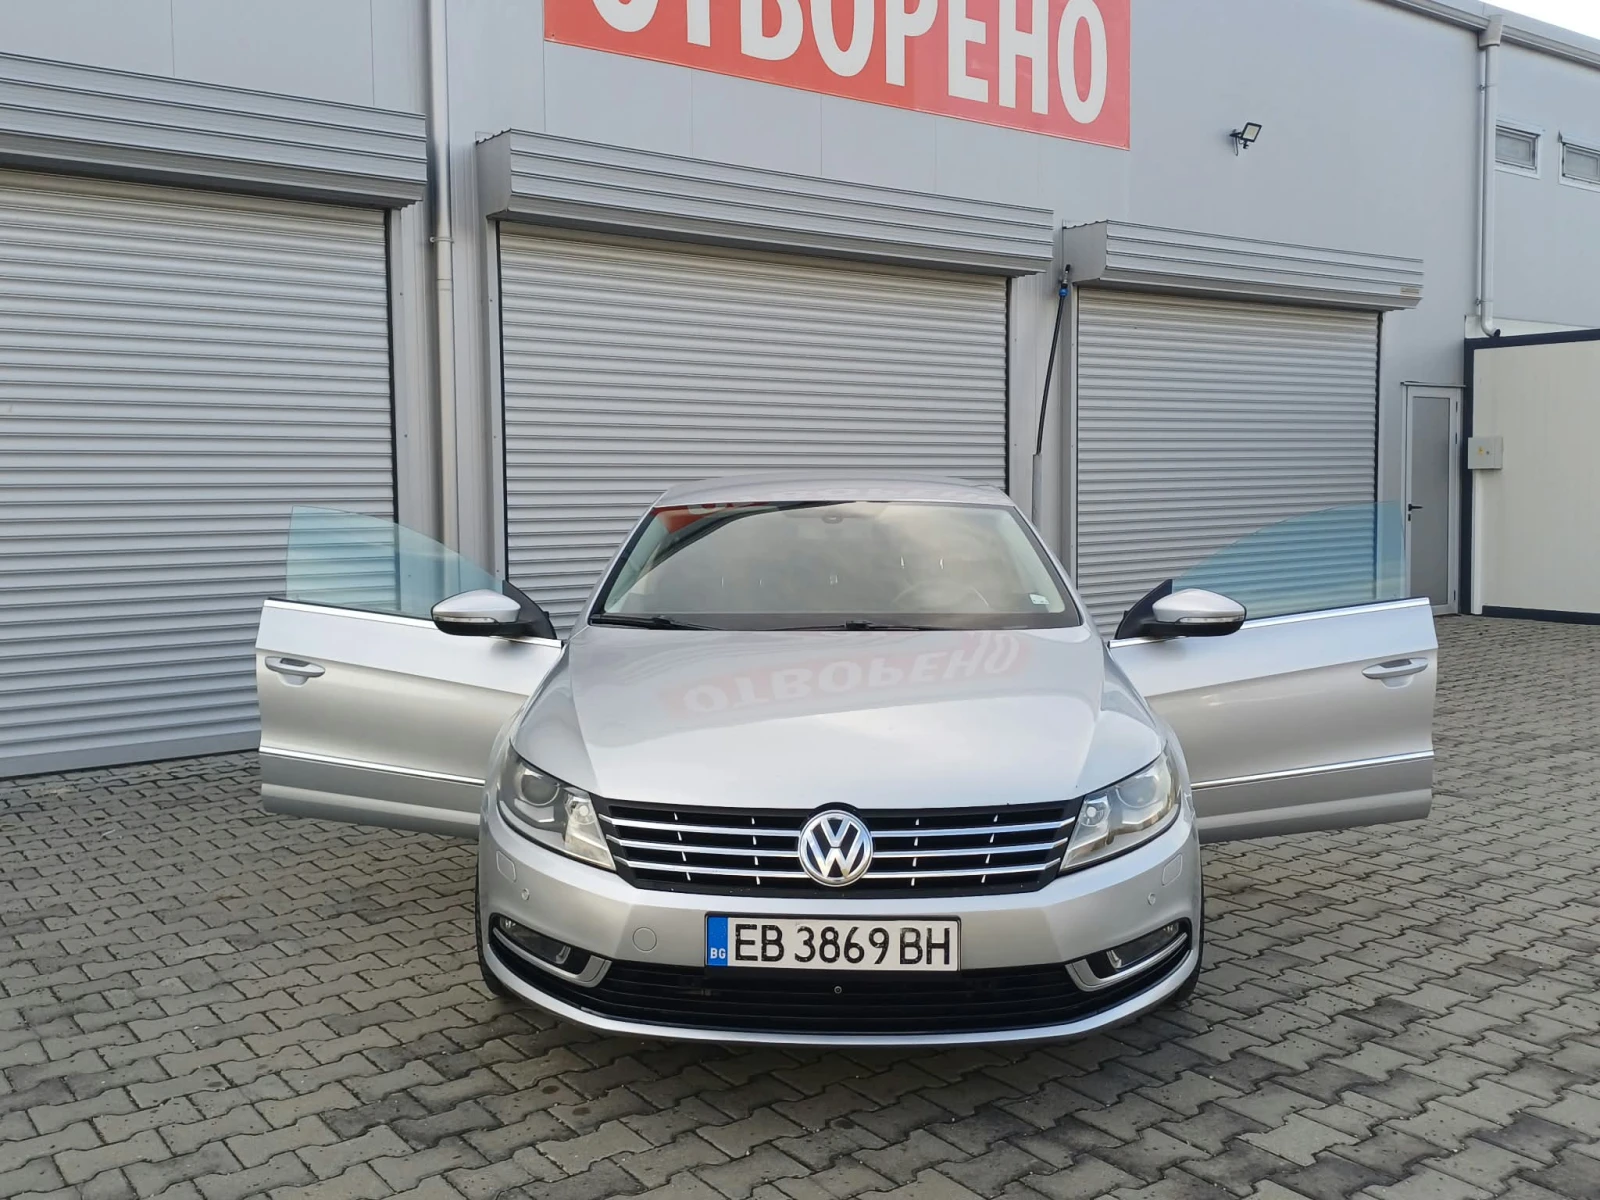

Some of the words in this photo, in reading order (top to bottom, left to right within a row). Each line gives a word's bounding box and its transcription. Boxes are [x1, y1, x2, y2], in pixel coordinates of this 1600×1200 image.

[591, 0, 1108, 124] ОРЕНО
[801, 812, 871, 885] VW
[710, 947, 726, 960] BG
[735, 923, 785, 962] EB
[794, 925, 890, 964] 3869
[899, 927, 950, 965] BH
